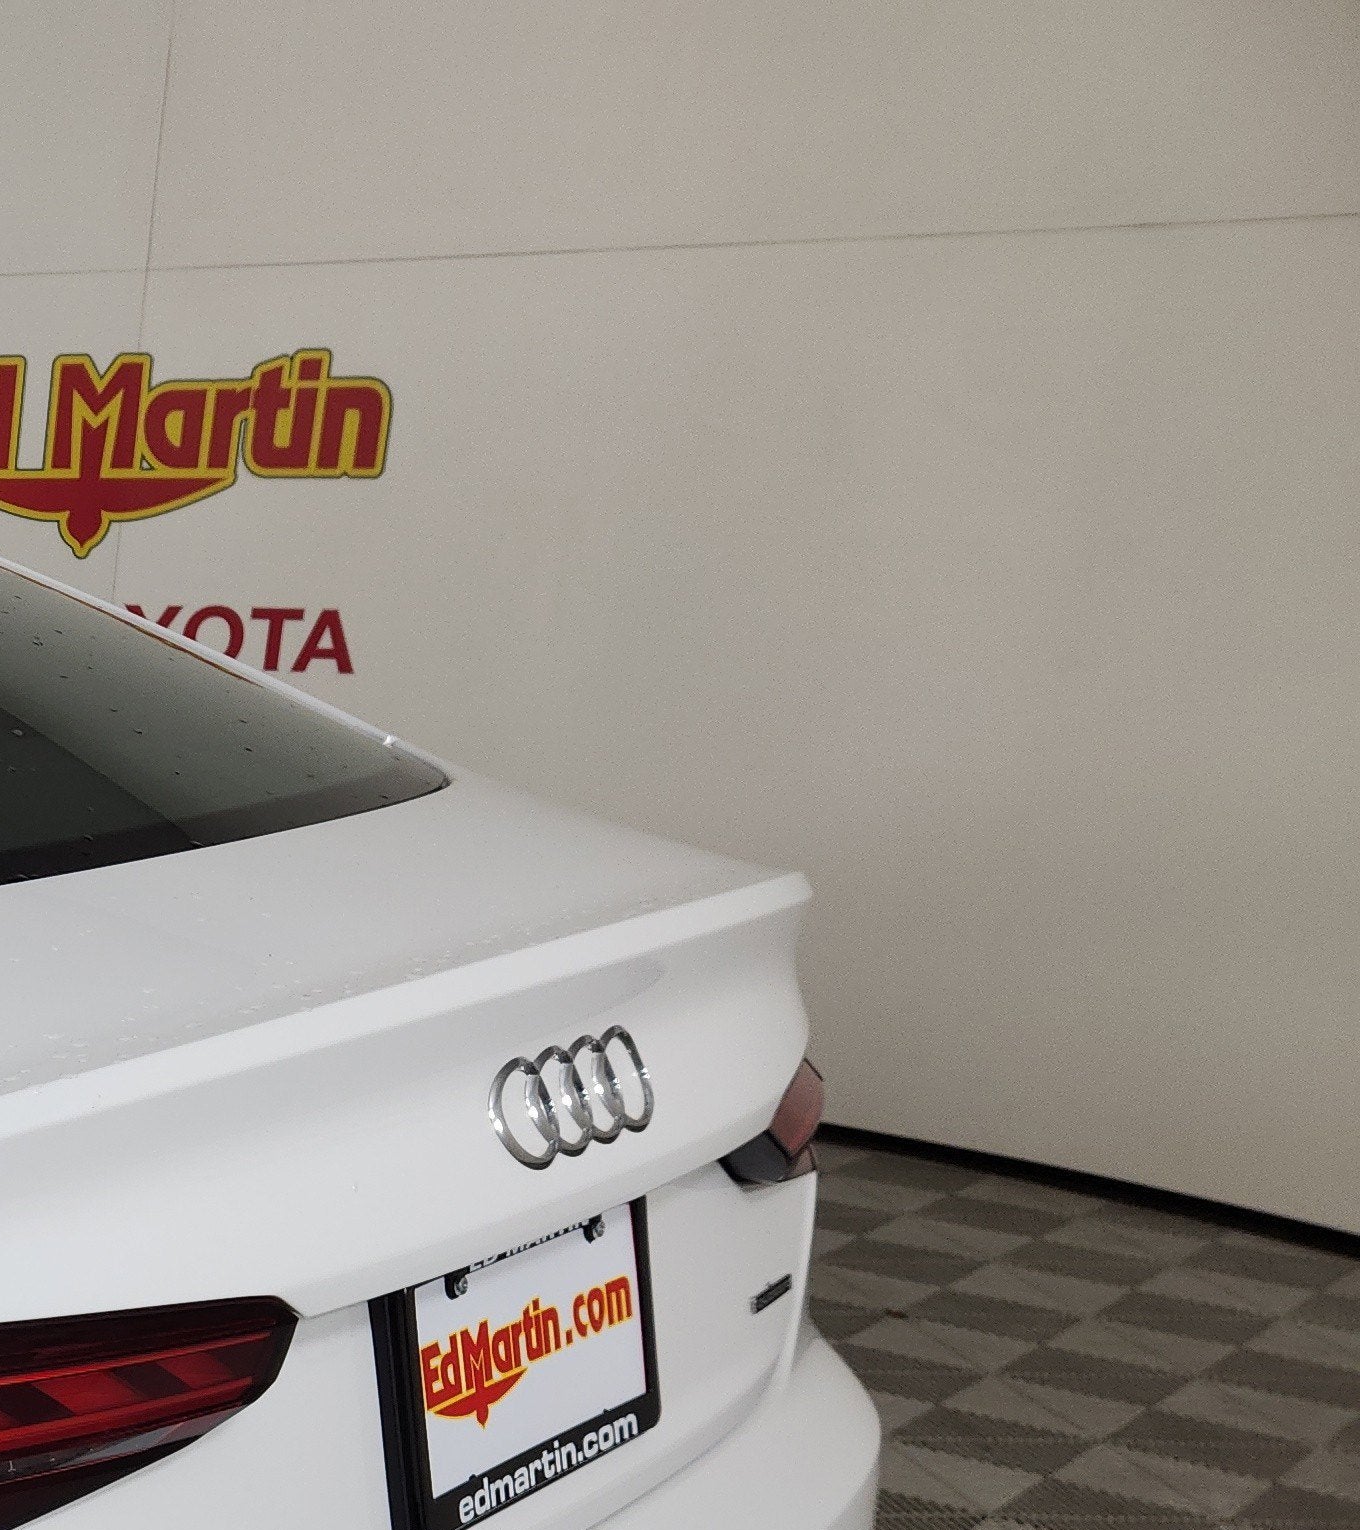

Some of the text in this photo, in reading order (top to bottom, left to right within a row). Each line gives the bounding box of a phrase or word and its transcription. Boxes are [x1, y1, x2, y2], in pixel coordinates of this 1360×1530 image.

[50, 352, 388, 475] Martin
[420, 1275, 634, 1406] EdMartin.com
[458, 1412, 640, 1525] edmartin.com
